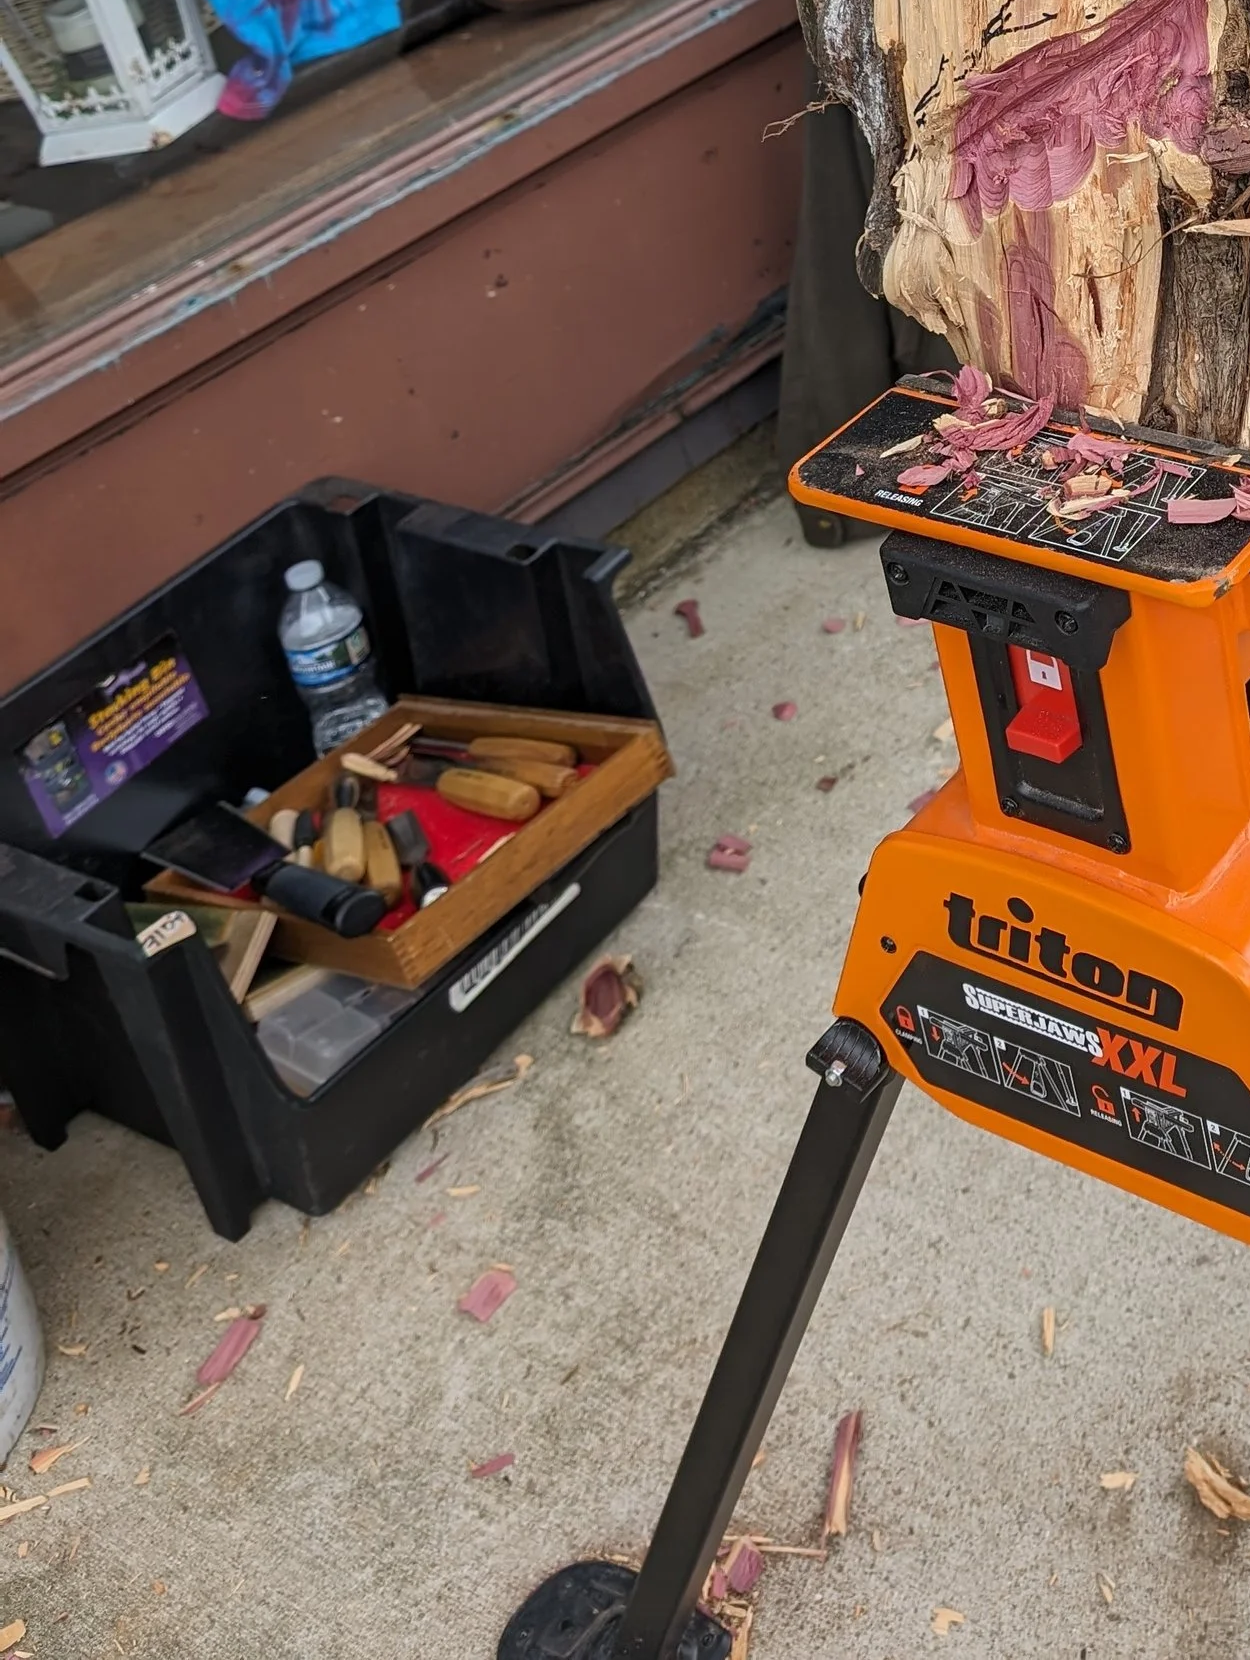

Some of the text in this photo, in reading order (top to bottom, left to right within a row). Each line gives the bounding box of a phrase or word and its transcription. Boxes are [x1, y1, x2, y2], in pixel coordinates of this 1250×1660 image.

[873, 489, 924, 508] RELEASING
[943, 891, 1184, 1031] triton
[962, 982, 1188, 1098] SUPERJAWS XXL
